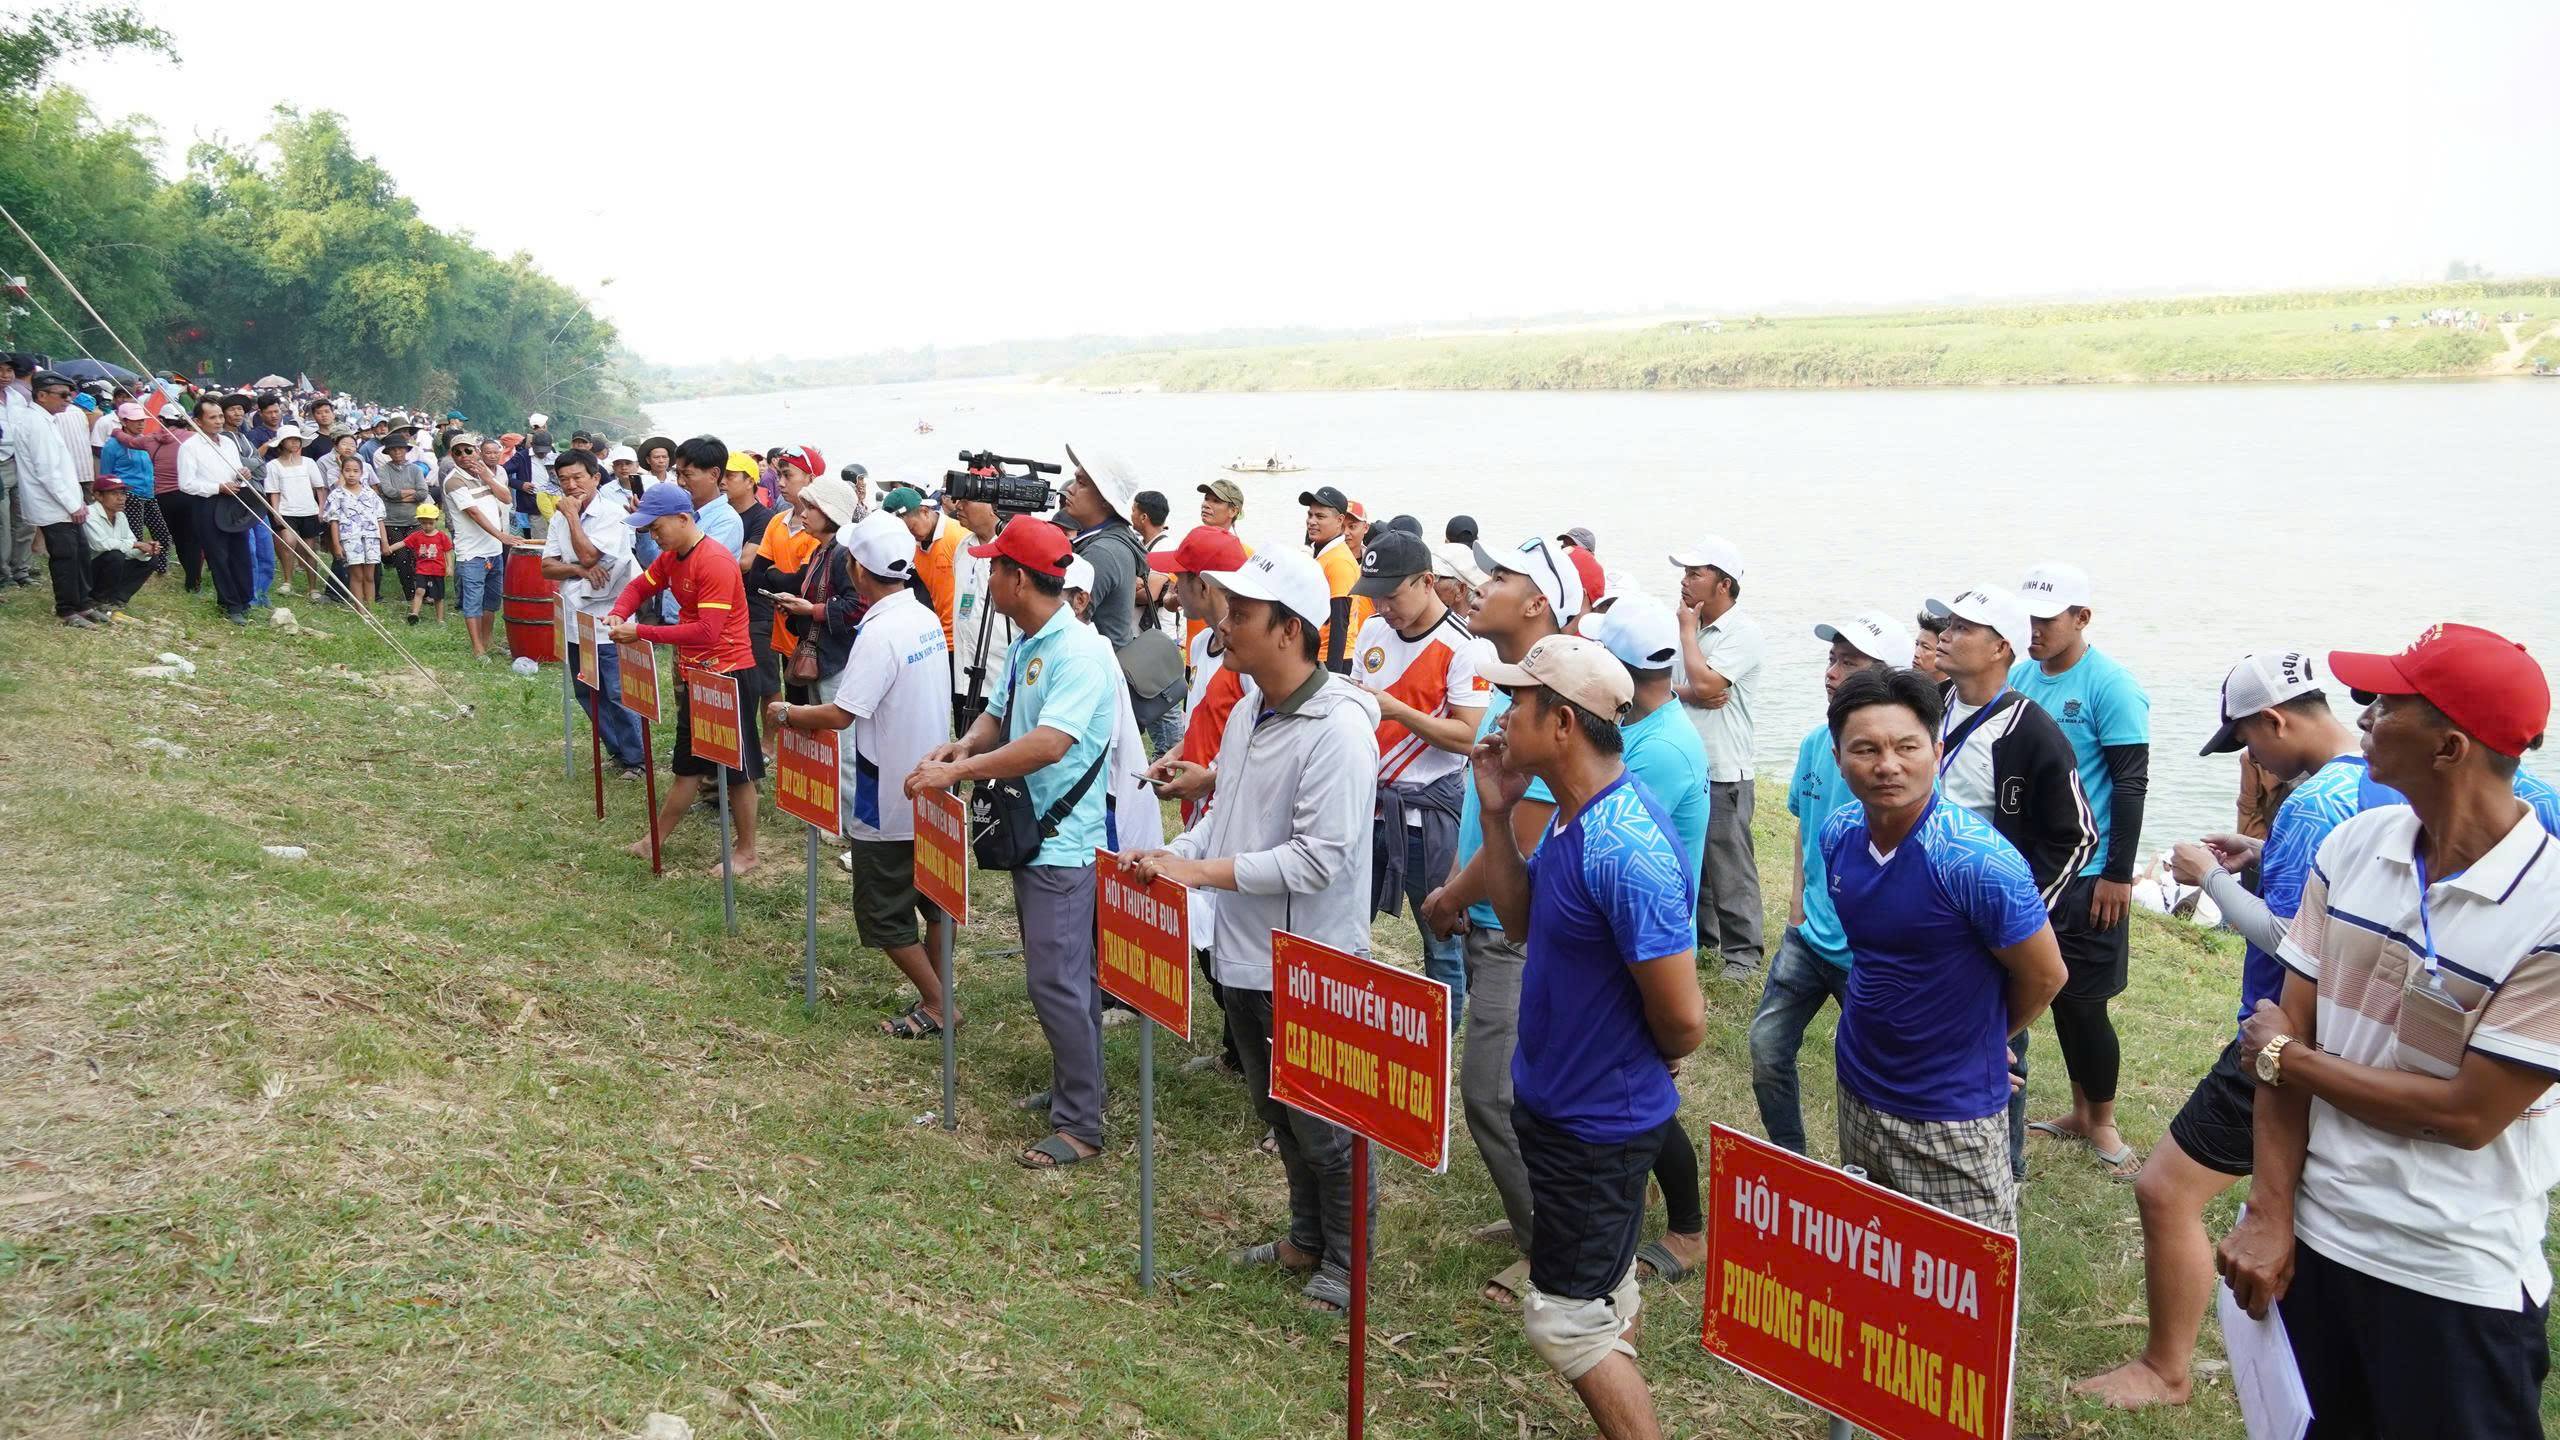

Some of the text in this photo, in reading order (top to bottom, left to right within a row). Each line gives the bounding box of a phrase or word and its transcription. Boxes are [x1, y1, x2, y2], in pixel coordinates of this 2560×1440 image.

[2039, 582, 2054, 593] AN
[2282, 652, 2300, 684] DSQU
[973, 814, 991, 824] didas
[1105, 874, 1181, 938] HỘI THUYỀN ĐUA
[1103, 928, 1128, 974] THANH
[1150, 952, 1171, 999] MINH
[1171, 964, 1184, 1007] AN
[1288, 961, 1429, 1048] HỘI THUYỀN ĐUA
[1285, 1020, 1307, 1070] CLB
[1310, 1031, 1333, 1089] ĐẠI
[1335, 1039, 1379, 1099] PHONG
[1387, 1060, 1408, 1111] VU
[1409, 1069, 1433, 1124] GIA
[1734, 1175, 1979, 1321] HỘI THUYỀN ĐUA
[1721, 1259, 1803, 1350] PHƯỜNG
[1808, 1287, 1845, 1369] CỦI
[1860, 1322, 1942, 1417] THĂNG
[1948, 1363, 1986, 1439] AN
